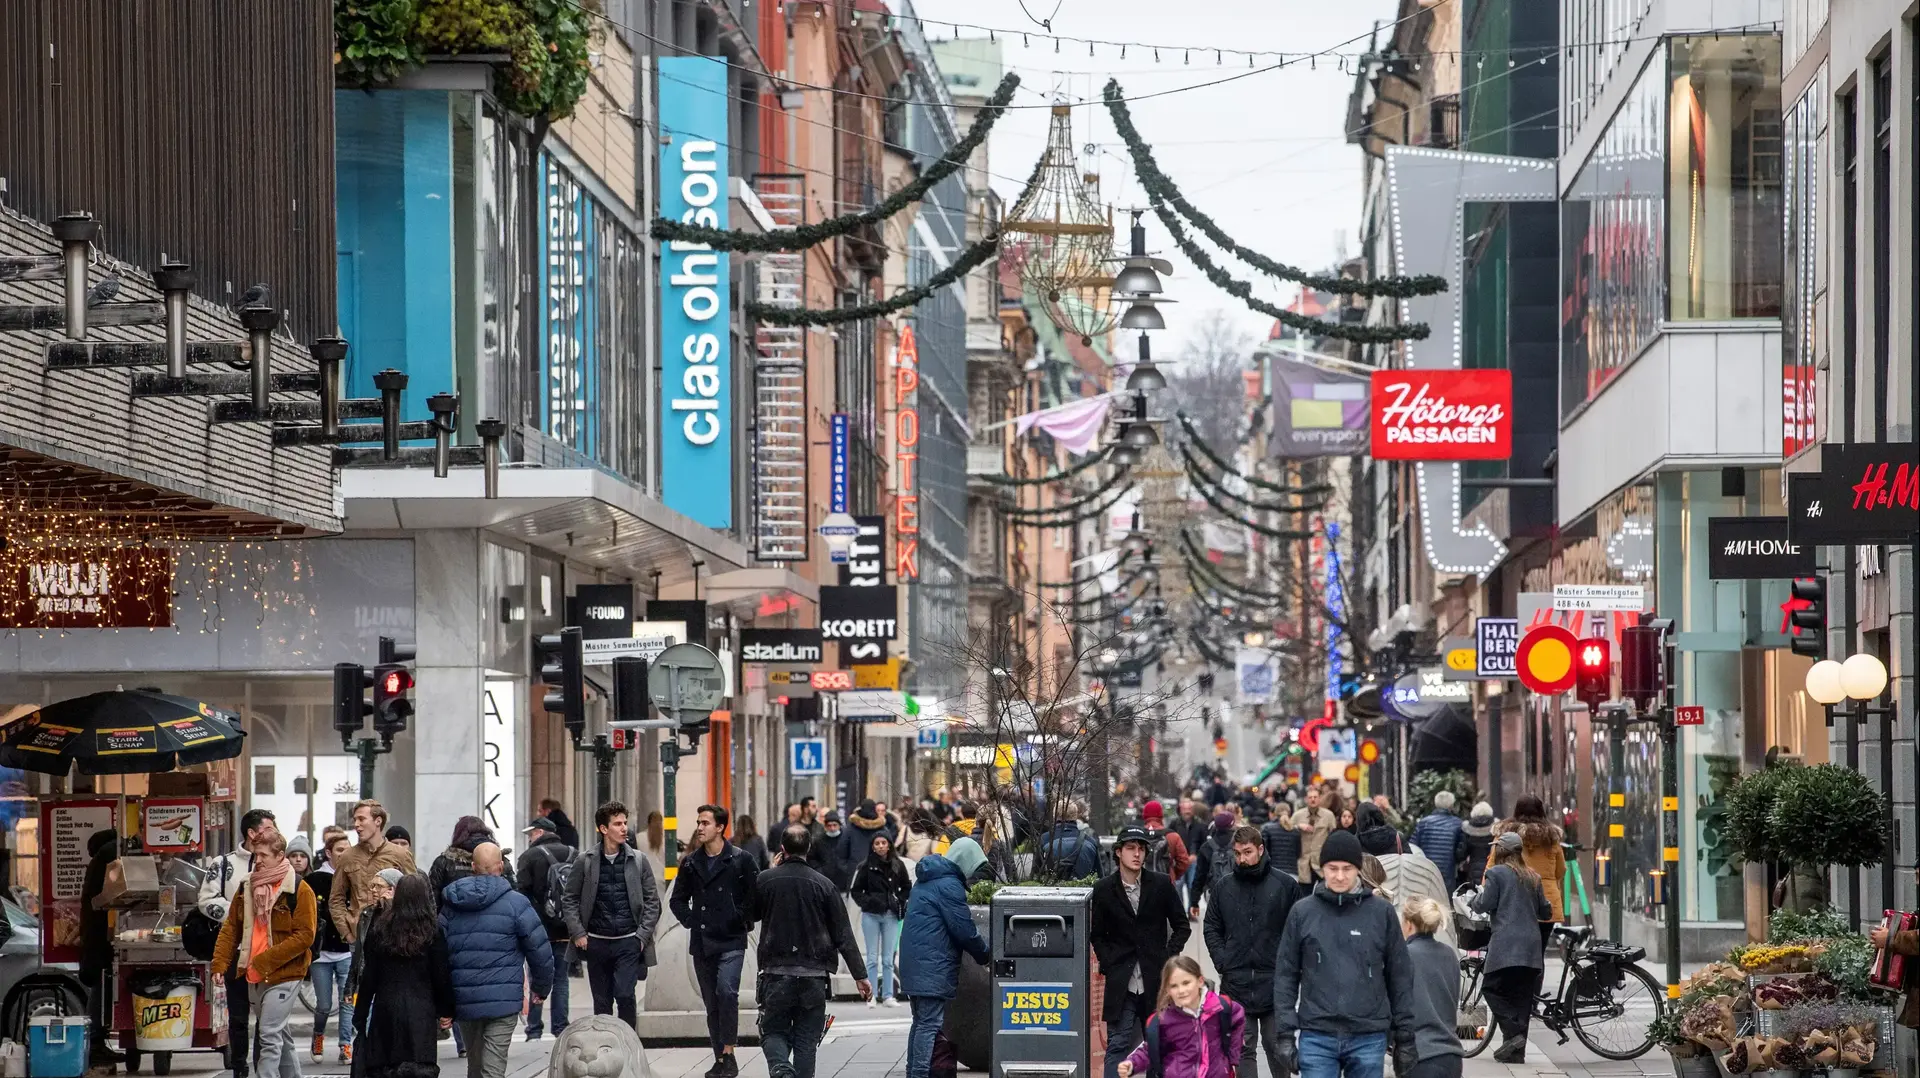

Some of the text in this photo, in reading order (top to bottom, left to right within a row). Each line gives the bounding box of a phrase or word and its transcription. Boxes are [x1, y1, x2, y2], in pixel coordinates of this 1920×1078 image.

[671, 333, 720, 445] clas
[1382, 382, 1504, 429] Hötorgs
[1386, 426, 1496, 443] PASSAGEN
[896, 325, 919, 578] APOTEK
[834, 416, 844, 513] RESTAURANG
[1852, 462, 1919, 511] H&M
[1748, 540, 1801, 555] HOME
[29, 562, 109, 595] MUJI
[1586, 588, 1639, 598] Samuelsgatan
[822, 619, 896, 637] SCORETT
[742, 643, 820, 660] stadium
[1484, 640, 1519, 653] BER
[1678, 710, 1701, 722] 19,1
[1002, 992, 1069, 1009] JESUS
[142, 1003, 181, 1028] MER
[1011, 1012, 1062, 1024] SAVES
